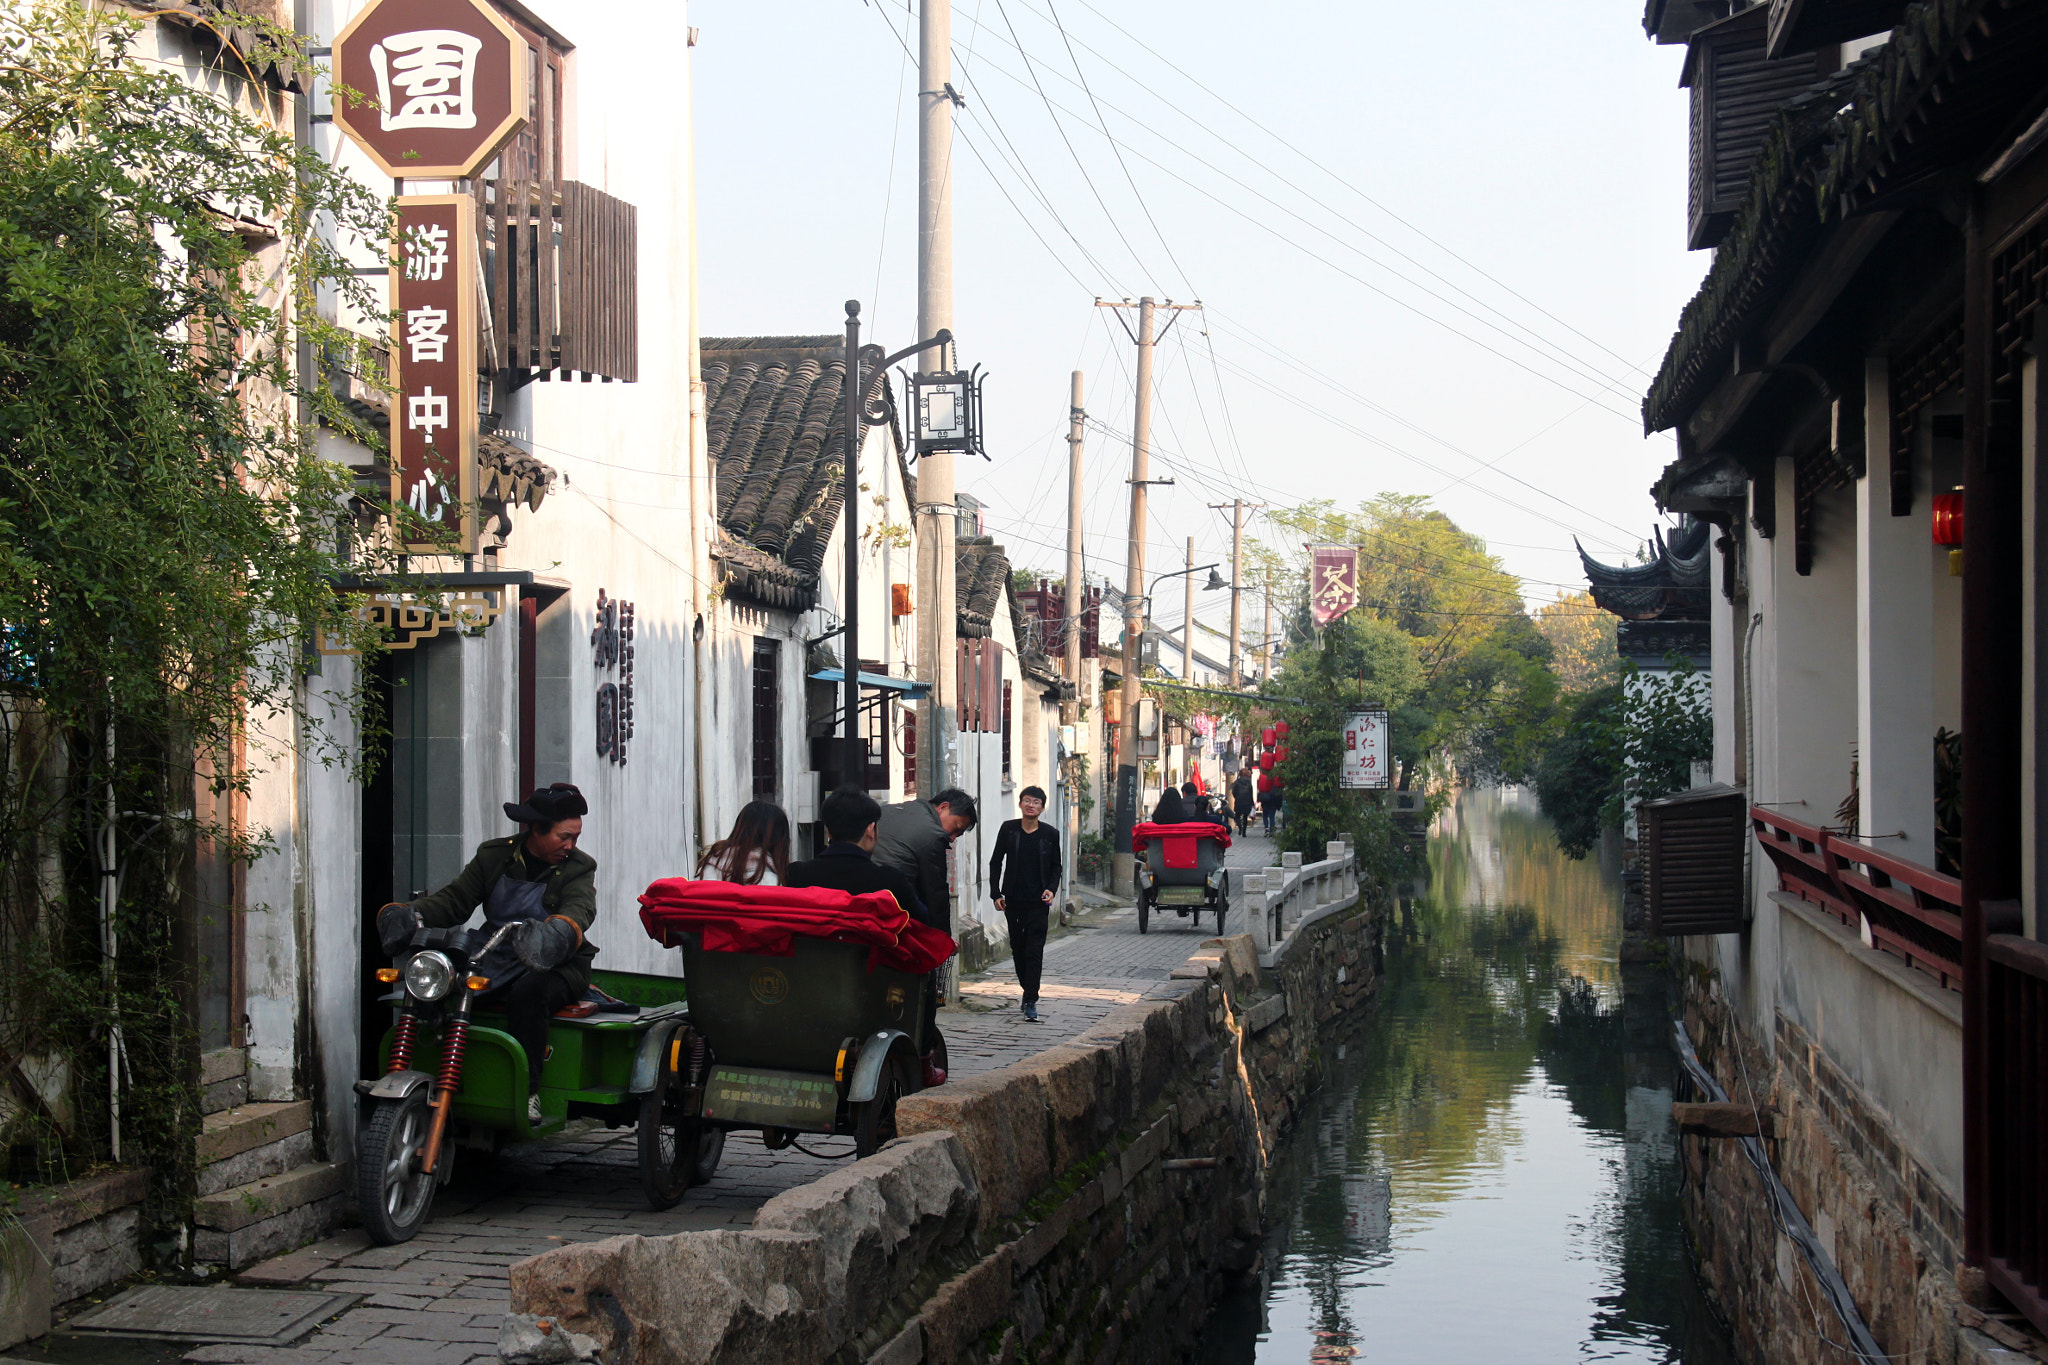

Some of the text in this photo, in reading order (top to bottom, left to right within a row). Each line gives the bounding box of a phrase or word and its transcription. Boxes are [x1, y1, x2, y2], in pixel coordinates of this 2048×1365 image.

[405, 223, 451, 523] 游客中心
[1315, 563, 1353, 610] 茶
